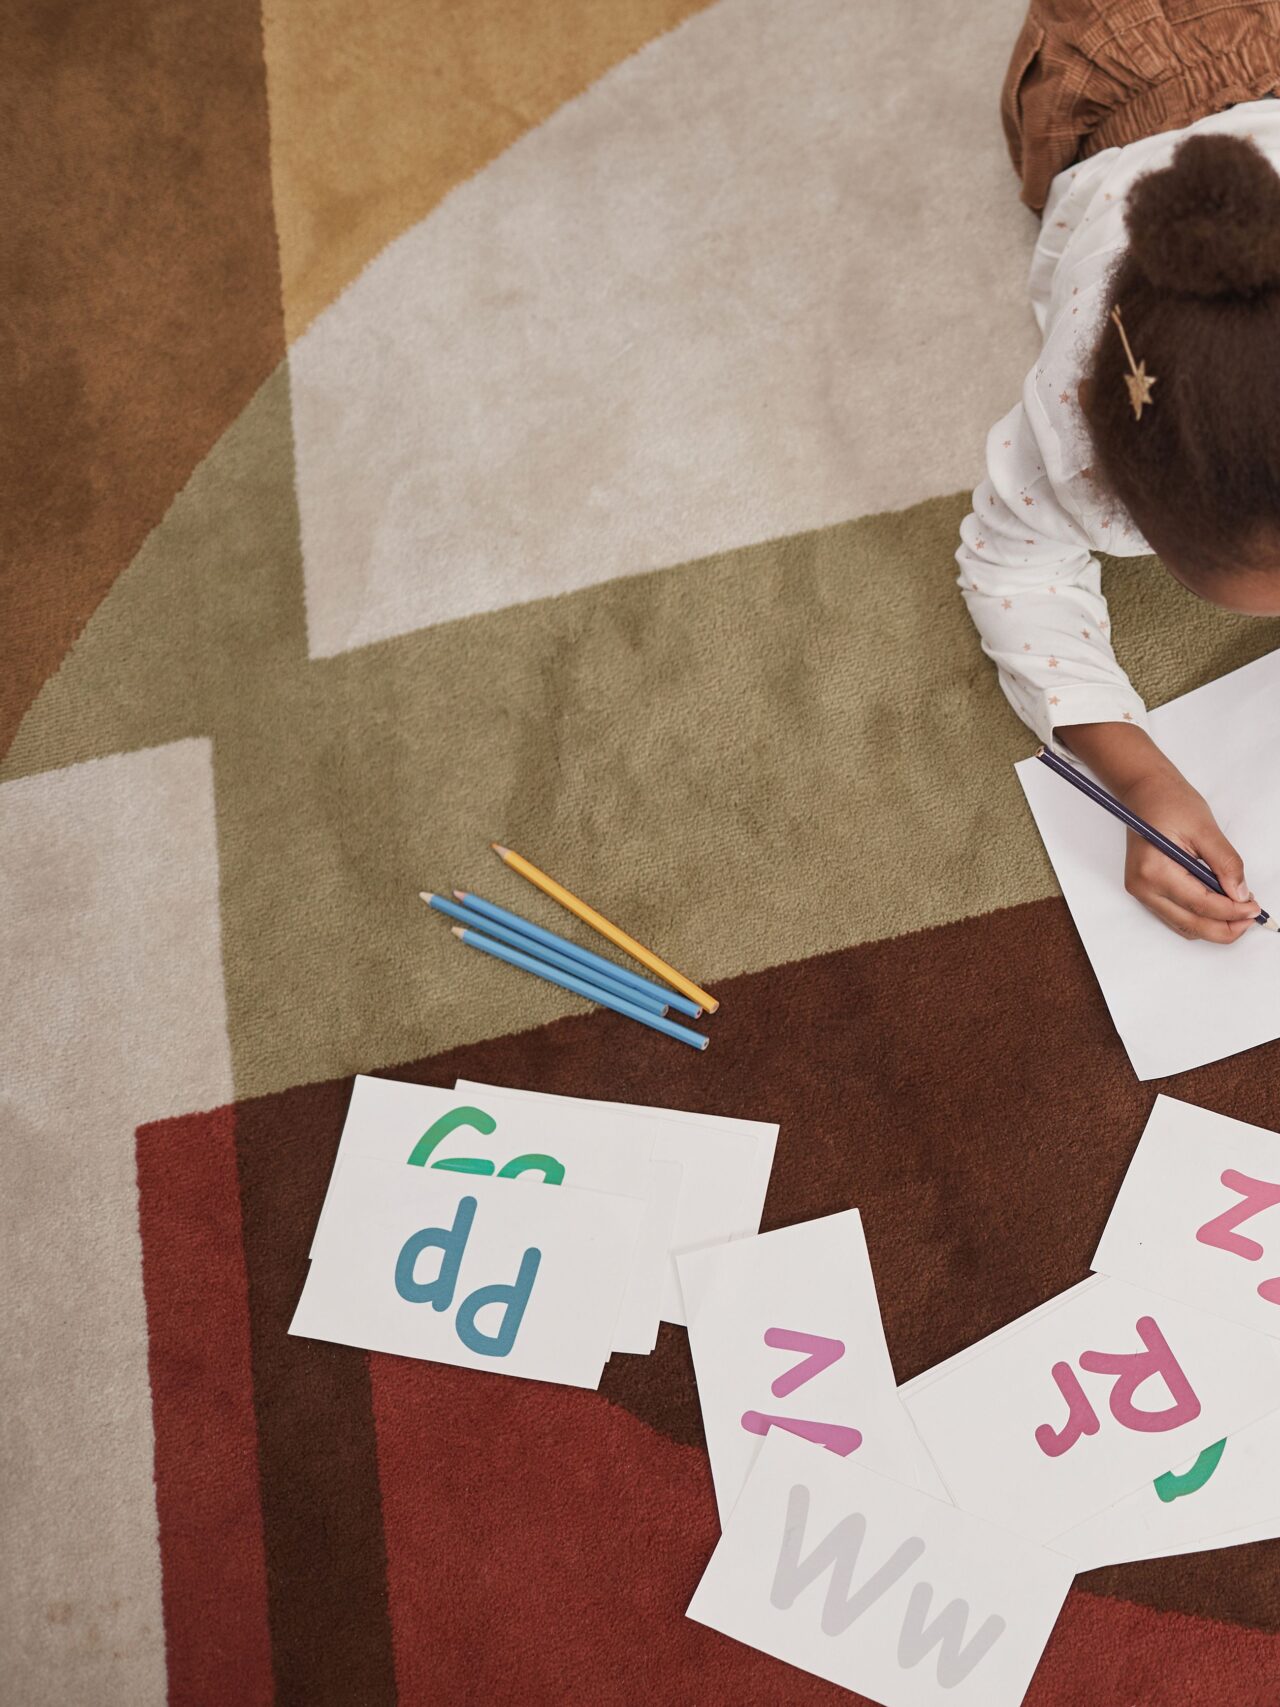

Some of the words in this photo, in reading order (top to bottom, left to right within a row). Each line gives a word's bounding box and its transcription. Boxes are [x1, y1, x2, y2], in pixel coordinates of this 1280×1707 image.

[394, 1196, 542, 1357] Pp
[1035, 1315, 1201, 1457] Rr
[769, 1483, 1007, 1690] Ww
